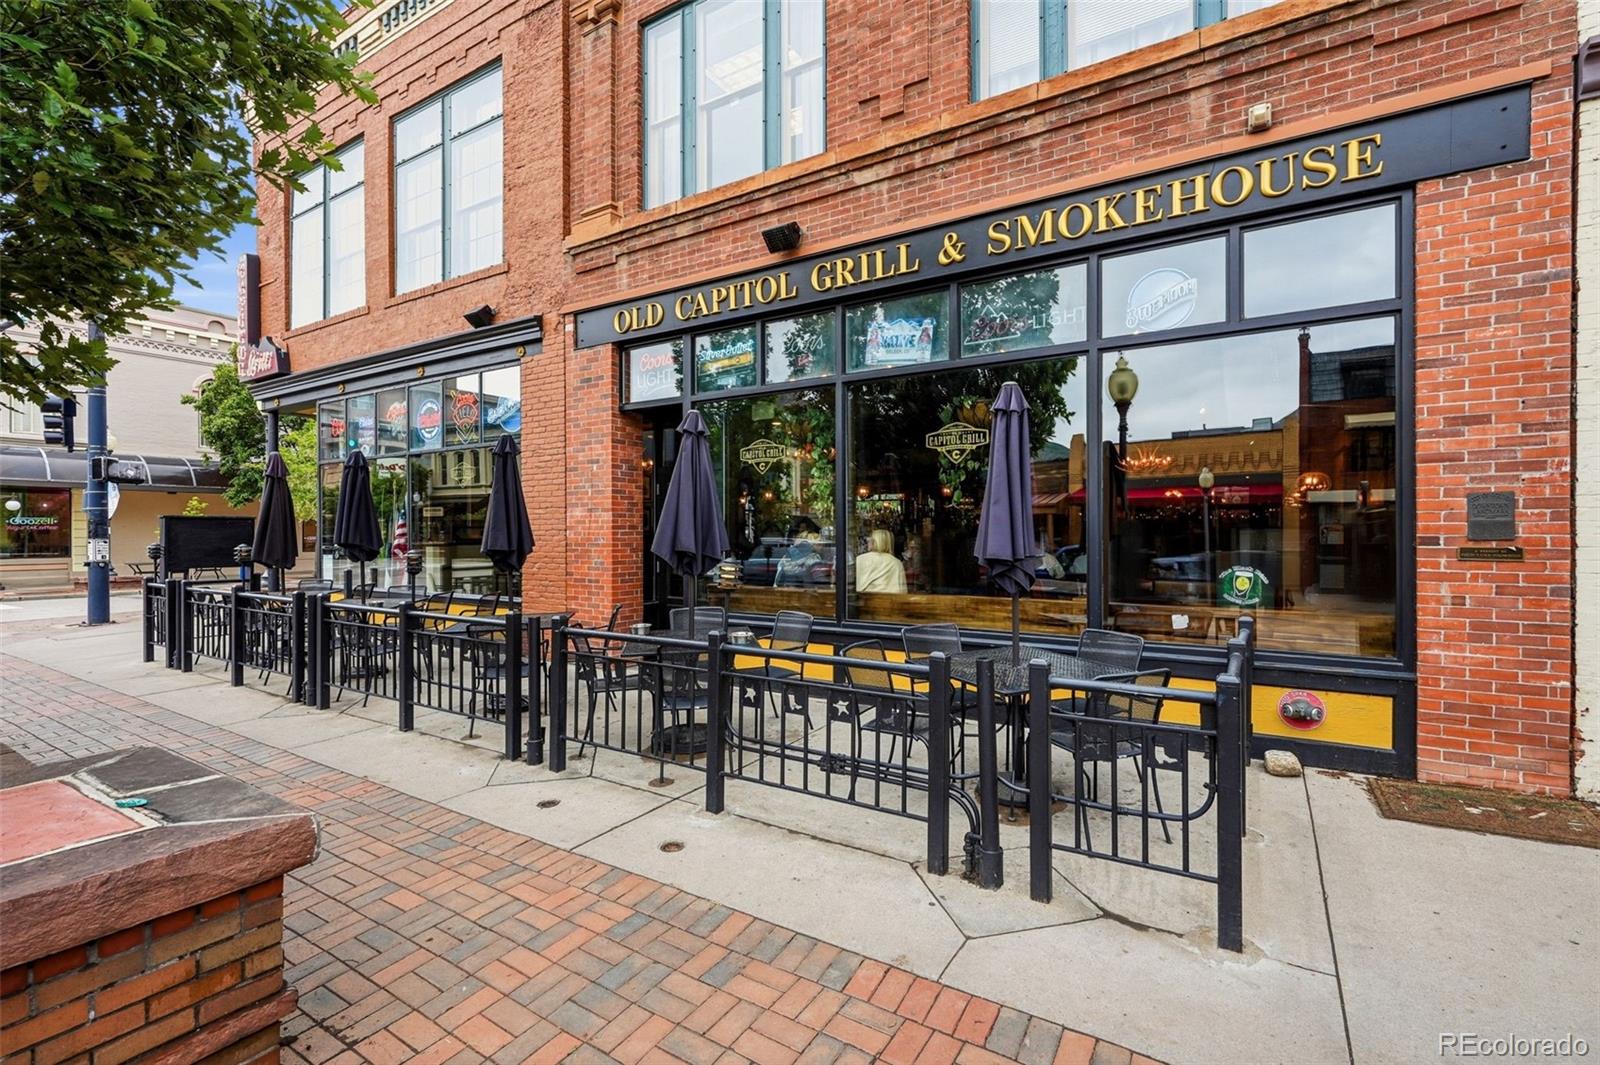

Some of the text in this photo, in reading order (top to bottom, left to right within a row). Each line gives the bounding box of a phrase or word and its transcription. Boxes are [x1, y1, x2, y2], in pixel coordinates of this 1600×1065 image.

[613, 133, 1384, 334] OLD CAPITOL GRILL & SMOKEHOUSE
[1032, 305, 1087, 329] LIGHT
[641, 352, 677, 372] Coors
[637, 368, 672, 388] LIGHT
[929, 432, 985, 447] CAPITOL GRILL
[9, 510, 54, 525] Goozell
